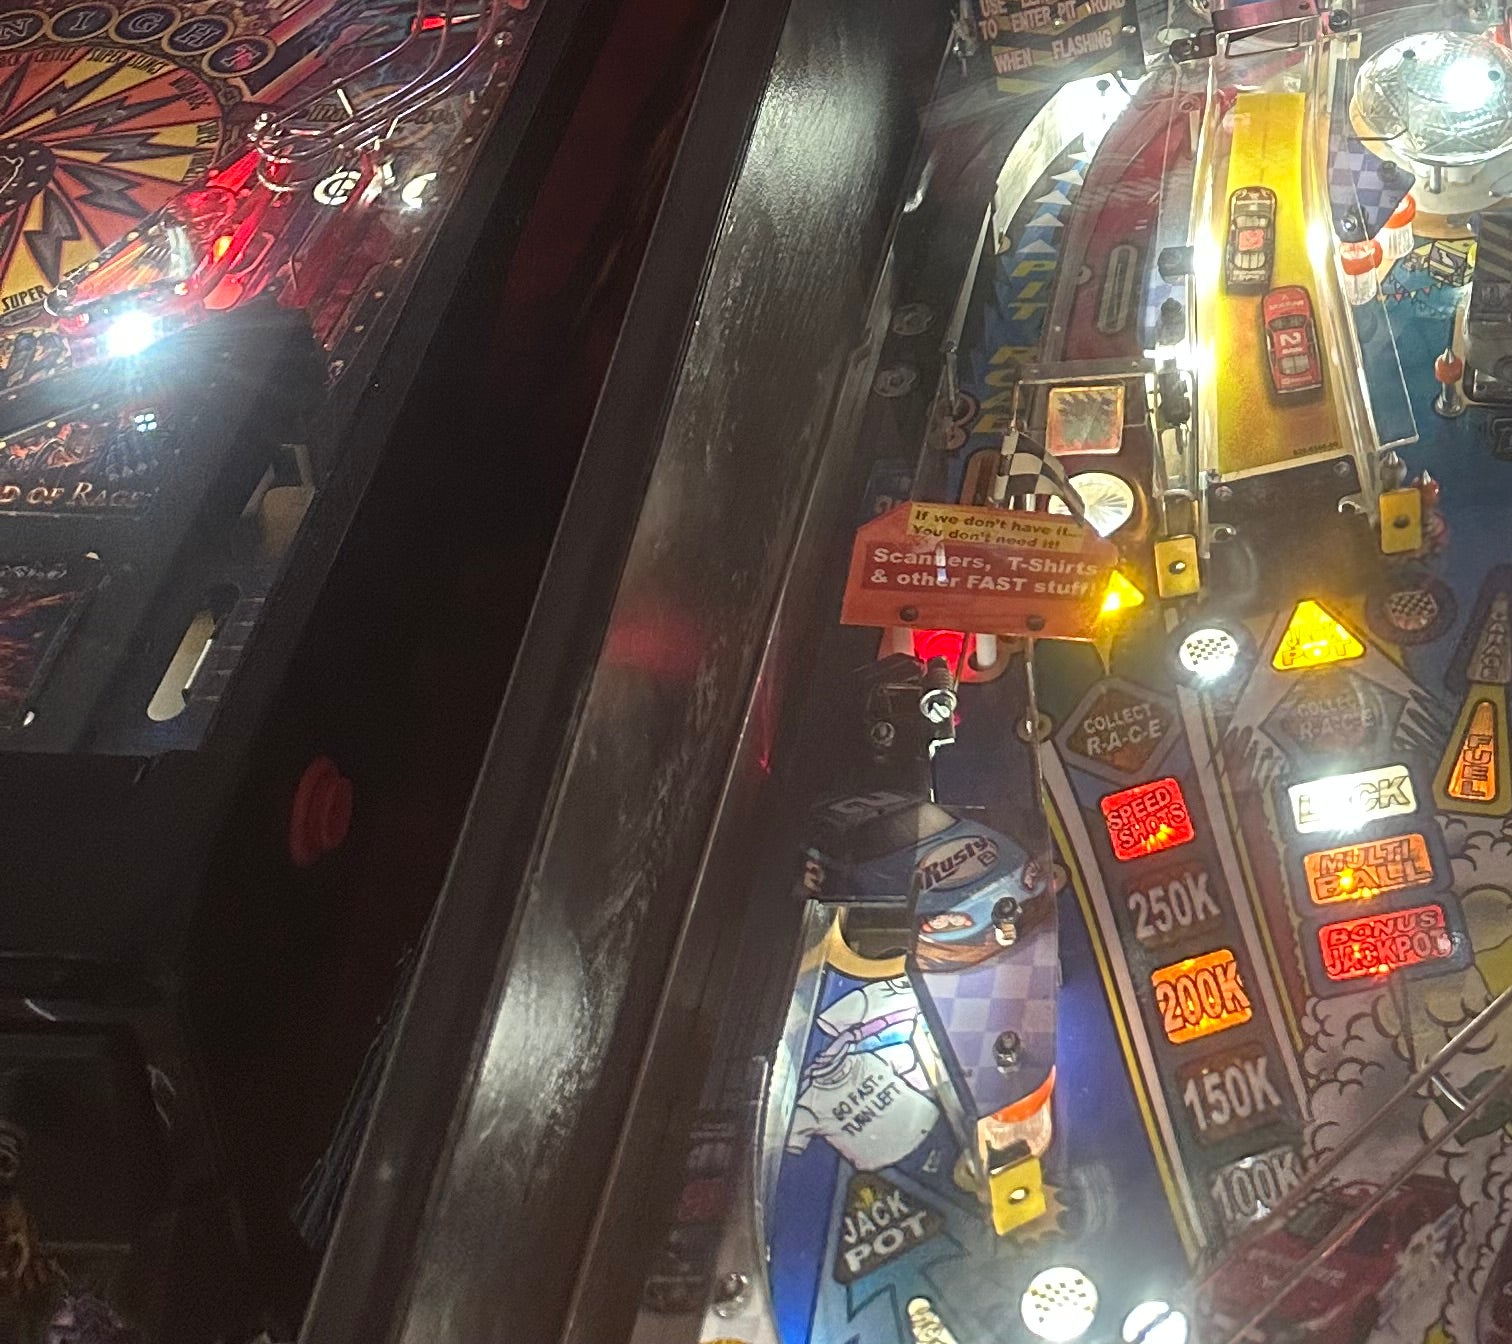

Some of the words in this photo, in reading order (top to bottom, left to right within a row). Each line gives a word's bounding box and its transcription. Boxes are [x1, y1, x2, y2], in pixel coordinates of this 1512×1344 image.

[978, 18, 999, 41] TO
[1010, 5, 1052, 33] ENTER
[993, 46, 1033, 74] WHEN
[1051, 29, 1113, 60] FLASHING
[1, 285, 48, 313] SUPER
[911, 524, 944, 540] You
[948, 529, 992, 542] don't
[996, 536, 1037, 547] need
[915, 511, 930, 523] If
[934, 512, 959, 525] we
[963, 515, 1008, 528] don't
[1011, 519, 1050, 536] have
[871, 568, 887, 583] &
[890, 570, 960, 588] other
[967, 575, 1027, 592] FAST
[1007, 556, 1098, 578] T-Shirts
[1083, 702, 1155, 738] COLLECT
[1086, 720, 1163, 757] R-A-C-E
[1460, 733, 1492, 798] FUEL
[1107, 788, 1171, 832] SPEED
[1119, 804, 1186, 850] SHOTS
[916, 837, 988, 893] Rusty
[1318, 839, 1411, 876] MULTI
[1316, 861, 1433, 903] BALL
[1128, 869, 1224, 945] 250K
[1328, 909, 1438, 945] BONUS
[1325, 929, 1452, 979] JACKPOT
[1155, 962, 1251, 1036] 200K
[870, 1081, 901, 1111] LEFT
[1183, 1056, 1281, 1132] 150K
[1211, 1143, 1303, 1224] 100K
[842, 1189, 905, 1245] JACK
[844, 1209, 928, 1273] POT
